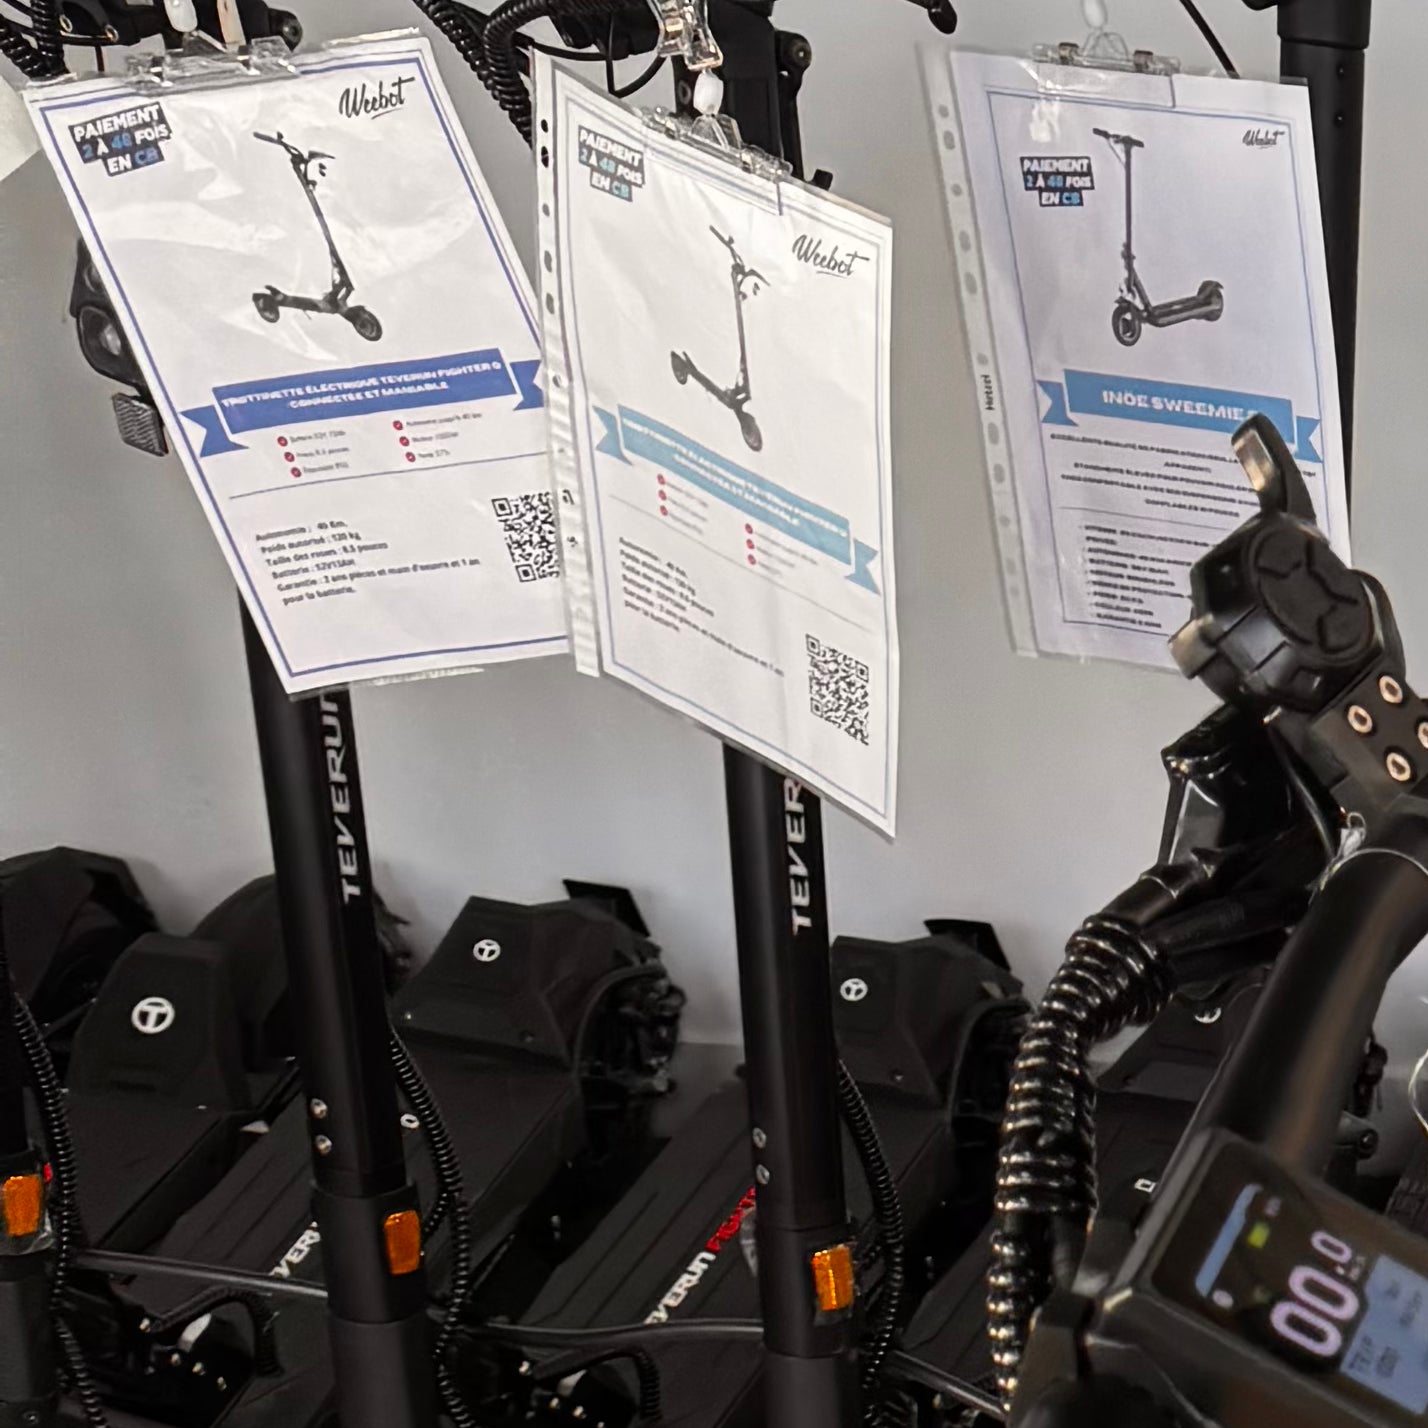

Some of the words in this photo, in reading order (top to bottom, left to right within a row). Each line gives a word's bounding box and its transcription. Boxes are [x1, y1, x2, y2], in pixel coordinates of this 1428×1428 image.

[339, 77, 415, 118] Weebot
[73, 105, 160, 142] PAIEMENT
[82, 145, 93, 158] 2
[96, 138, 109, 155] À
[134, 124, 168, 145] FOIS
[579, 130, 642, 166] PAIEMENT
[107, 156, 132, 173] EN
[134, 147, 159, 165] CB
[580, 148, 587, 161] 2
[590, 150, 597, 165] À
[617, 165, 642, 187] FOIS
[1022, 159, 1089, 173] PAIEMENT
[592, 174, 609, 190] EN
[611, 179, 628, 197] CB
[1026, 175, 1033, 188] 2
[1035, 173, 1045, 188] À
[1065, 176, 1091, 188] FOIS
[1042, 192, 1059, 205] EN
[1061, 192, 1080, 205] CB
[792, 234, 870, 277] Weebot
[435, 362, 488, 377] FIGHTER
[364, 389, 379, 398] ET
[1270, 1231, 1359, 1357] 00.0
